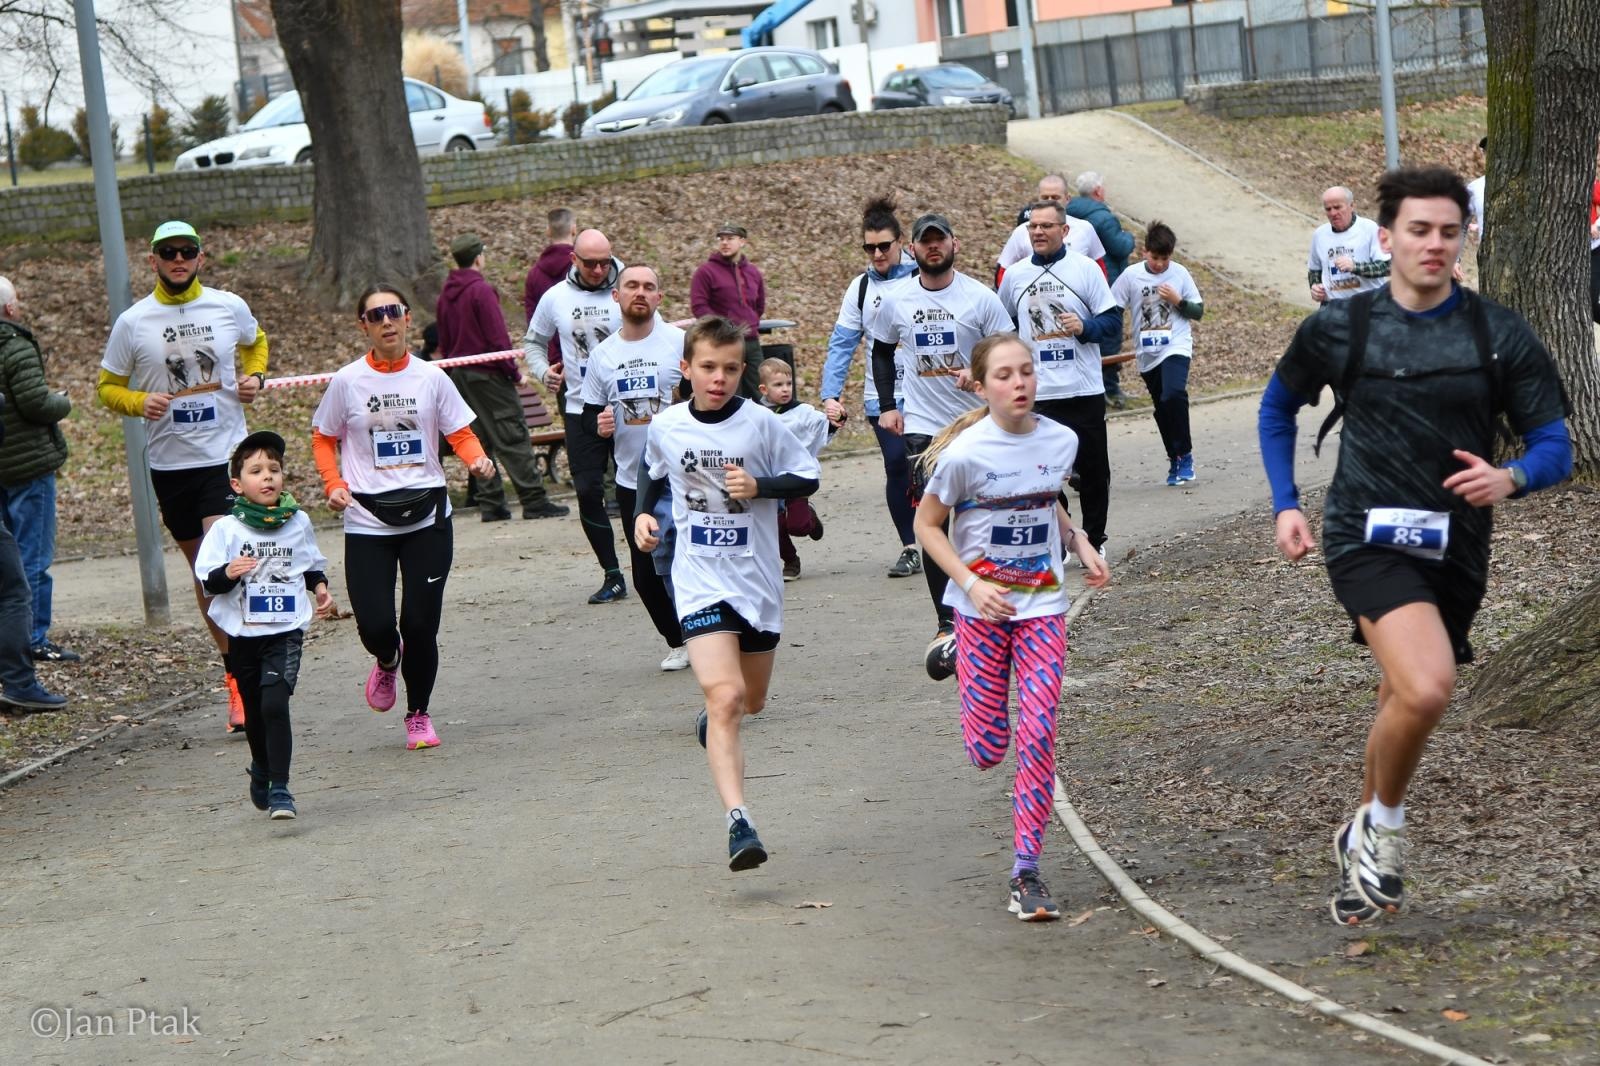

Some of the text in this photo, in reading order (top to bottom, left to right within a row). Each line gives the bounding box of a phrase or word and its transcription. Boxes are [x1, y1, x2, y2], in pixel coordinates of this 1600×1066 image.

[179, 325, 213, 337] WILCZYM
[928, 333, 944, 346] 98
[1151, 337, 1162, 346] 12
[1051, 350, 1065, 361] 15
[625, 377, 649, 391] 128
[383, 398, 417, 408] WILCZYM
[186, 410, 204, 423] 17
[391, 441, 410, 456] 19
[701, 449, 723, 457] TROPEM
[701, 457, 745, 468] WILCZYM
[703, 528, 738, 546] 129
[1011, 527, 1034, 545] 51
[1392, 527, 1423, 547] 85
[257, 547, 293, 557] WILCZYM
[265, 596, 284, 612] 18
